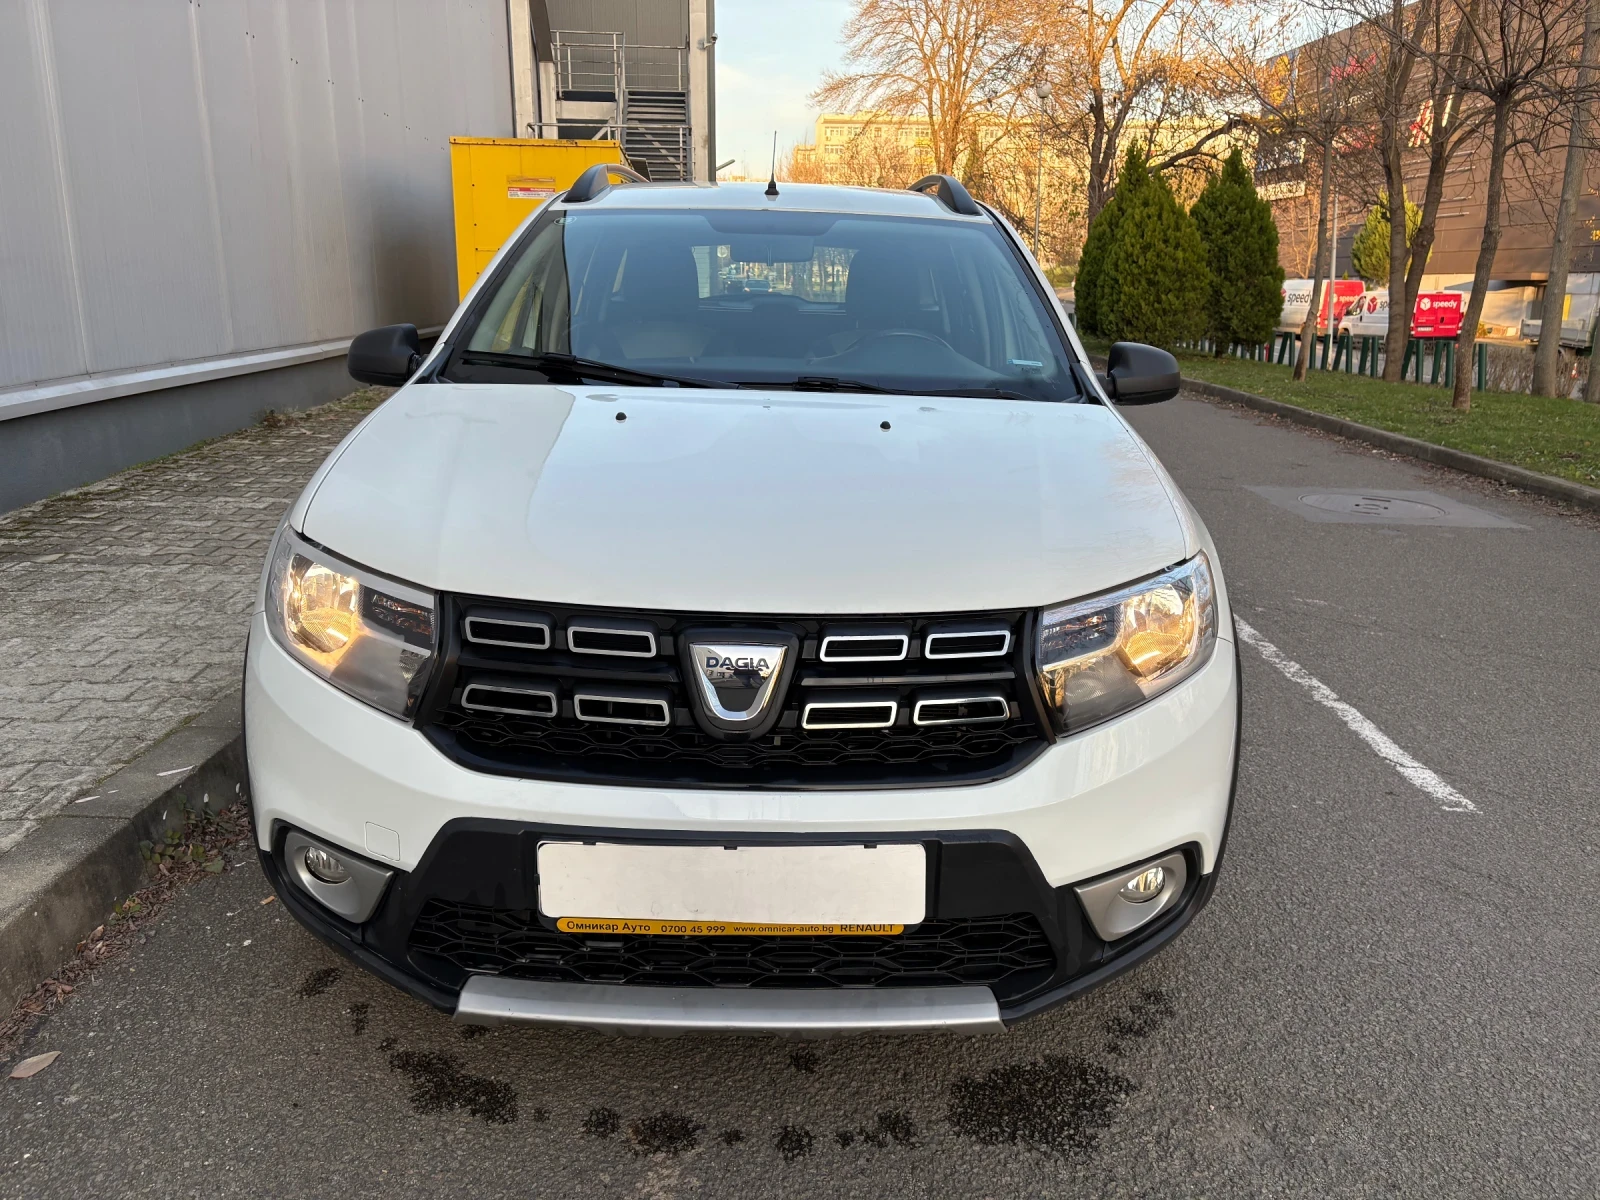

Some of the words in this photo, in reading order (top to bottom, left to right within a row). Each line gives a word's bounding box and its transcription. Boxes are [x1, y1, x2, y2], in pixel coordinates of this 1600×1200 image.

[1432, 300, 1457, 309] speedy
[566, 921, 619, 933] Омникар
[622, 922, 651, 932] Ауто
[661, 925, 687, 933] 0700
[690, 925, 703, 933] 45
[706, 925, 726, 934] 999
[733, 925, 834, 934] www.omnicar-auto.bg
[840, 924, 896, 933] RENAULT
